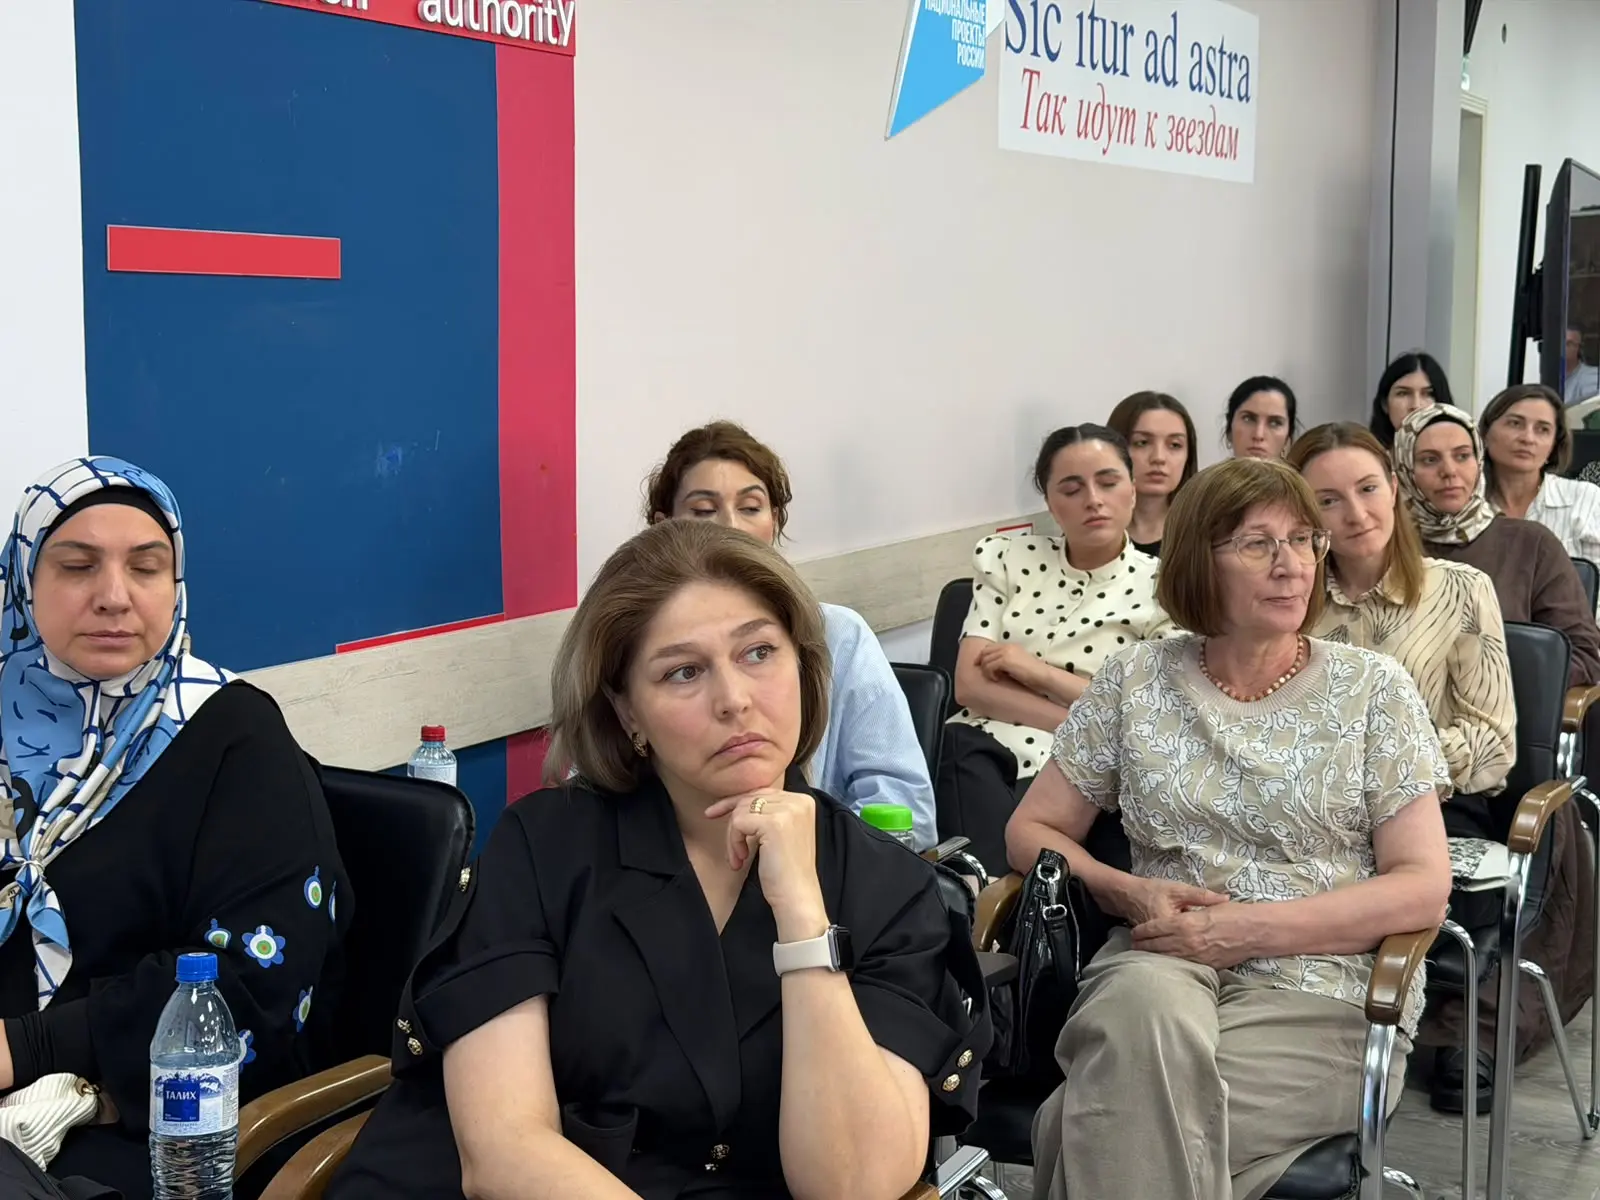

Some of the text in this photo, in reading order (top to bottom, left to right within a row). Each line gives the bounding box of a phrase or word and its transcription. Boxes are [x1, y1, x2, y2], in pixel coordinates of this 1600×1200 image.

[420, 0, 575, 47] authority
[951, 18, 986, 48] ПРОЕКТЫ
[956, 41, 985, 69] РОССИИ
[1004, 0, 1252, 104] Sic itur ad astra
[1019, 67, 1240, 161] Так идут к звездам
[165, 1090, 197, 1100] ТАЛИХ
